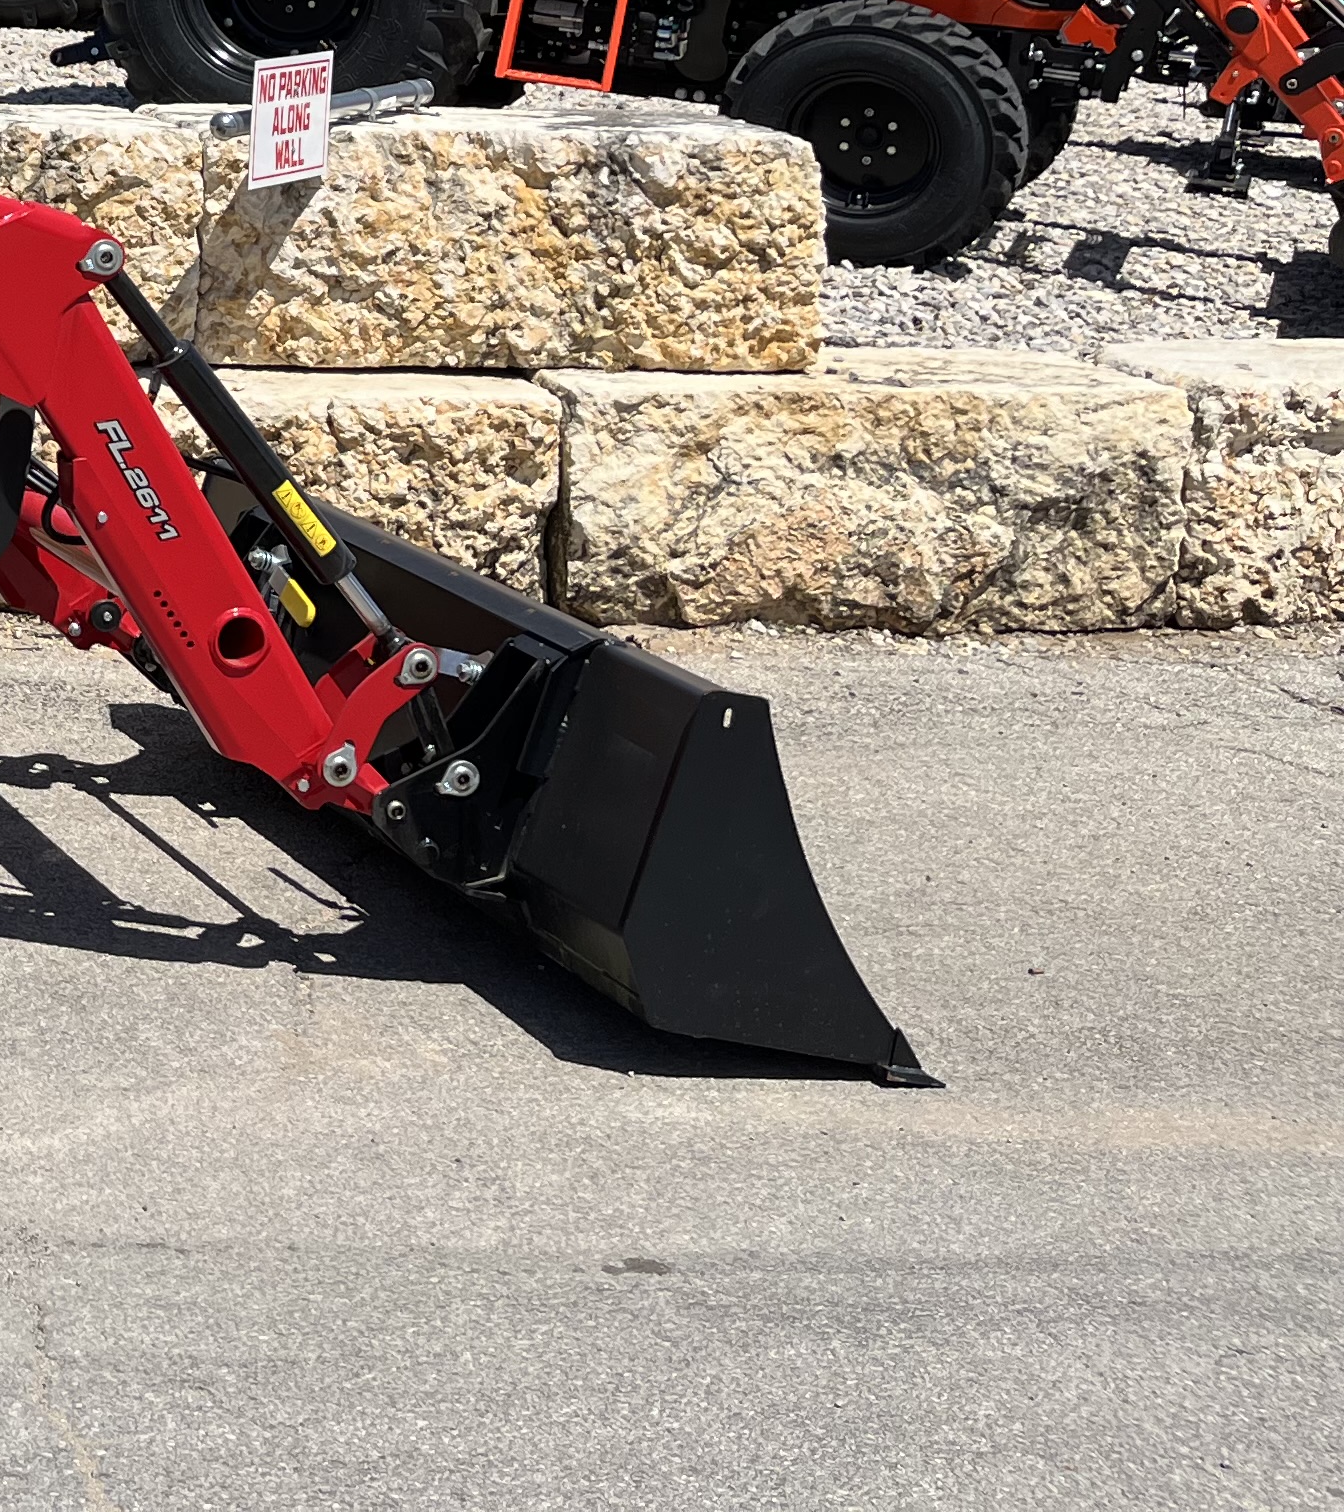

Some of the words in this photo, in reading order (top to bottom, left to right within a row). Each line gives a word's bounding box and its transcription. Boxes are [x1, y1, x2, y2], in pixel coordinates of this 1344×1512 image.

[258, 72, 277, 104] NO
[278, 65, 328, 102] PARKING
[271, 101, 311, 137] ALONG
[274, 137, 305, 171] WALL
